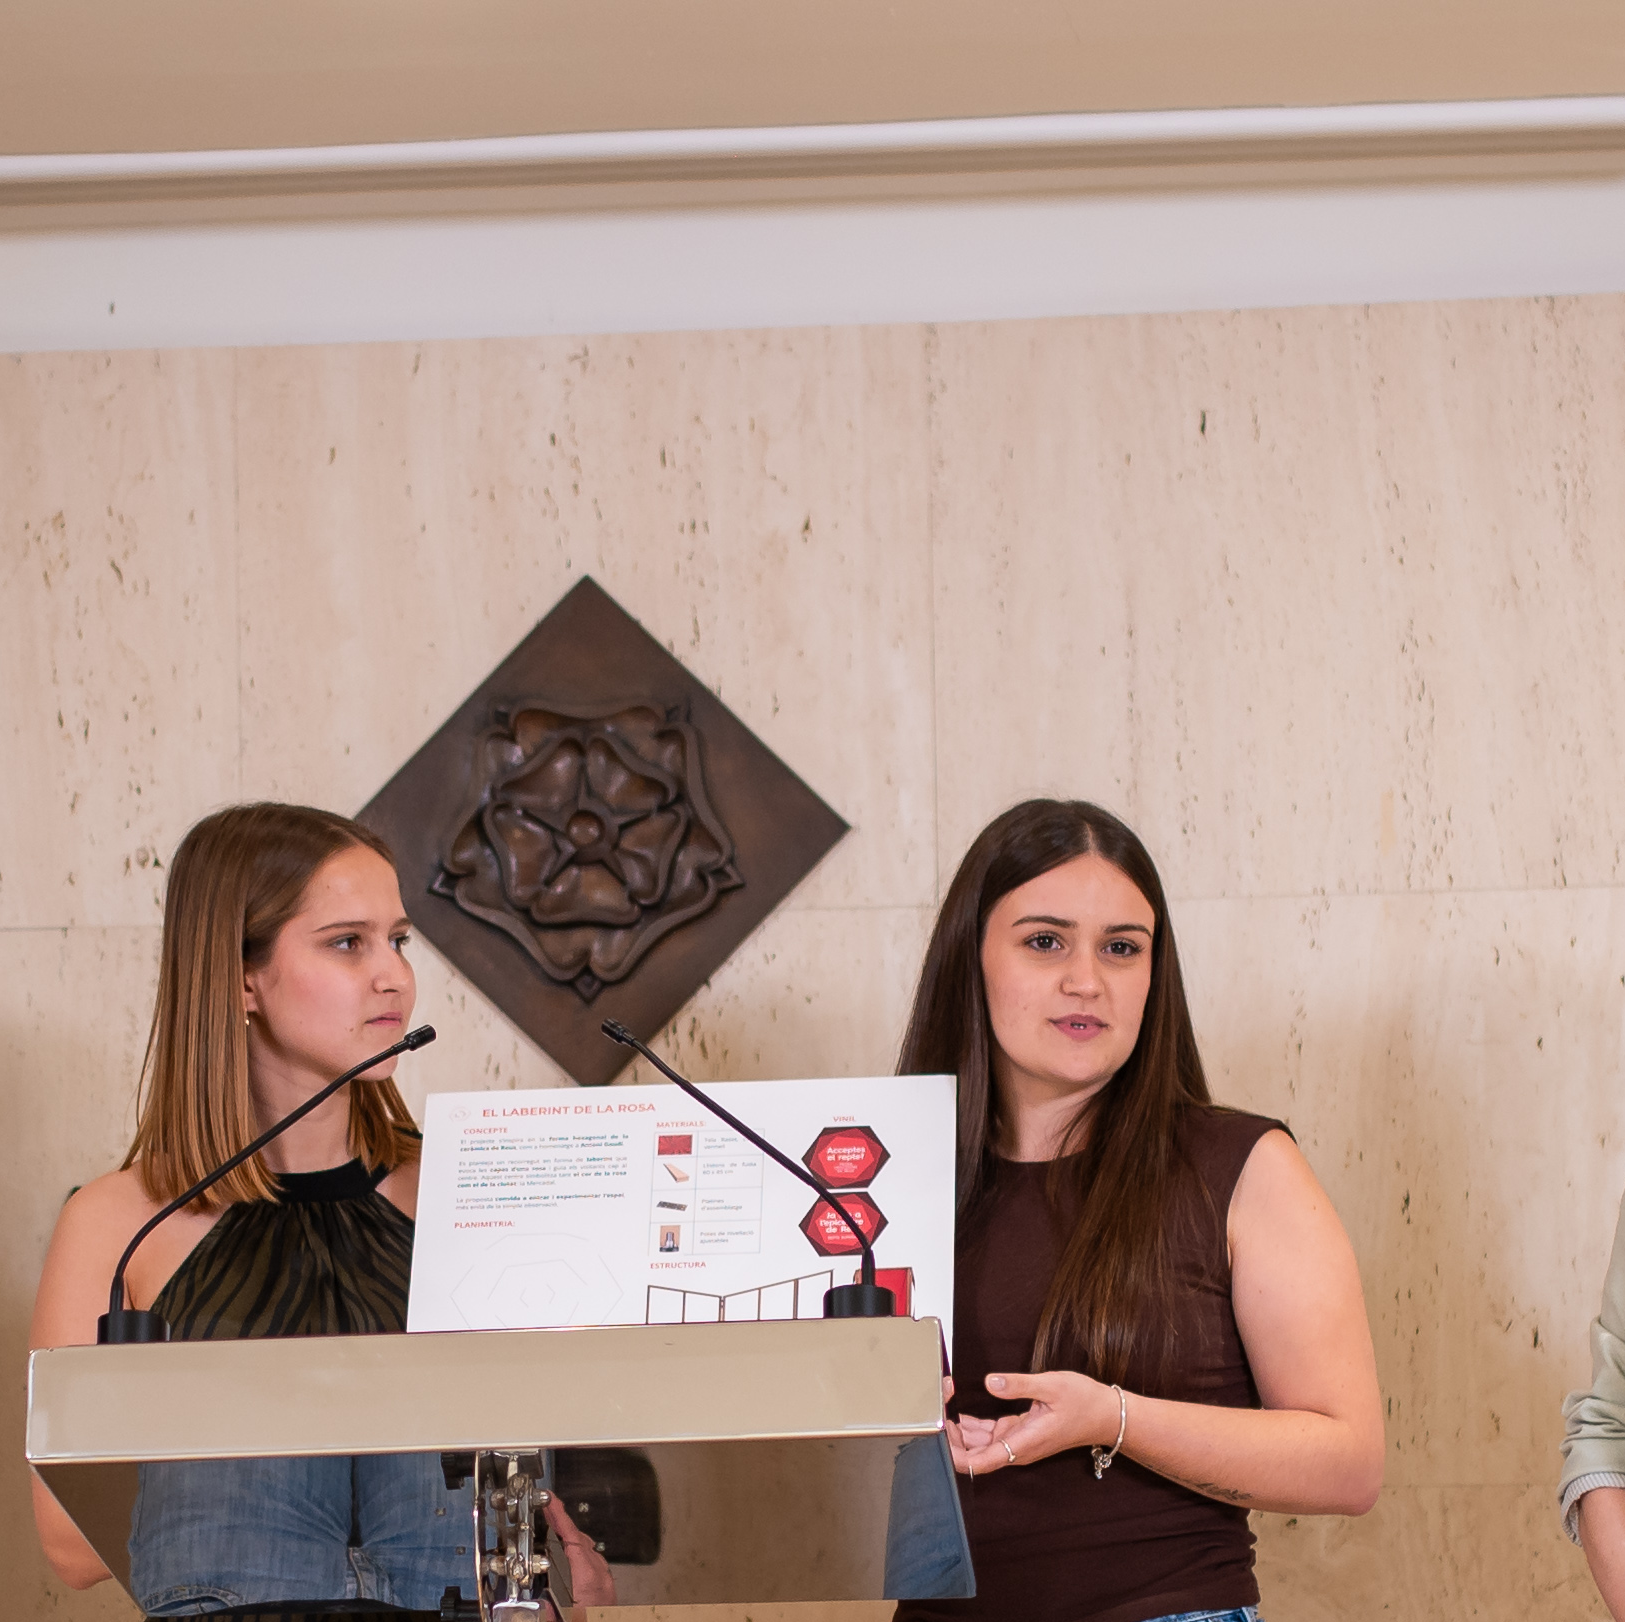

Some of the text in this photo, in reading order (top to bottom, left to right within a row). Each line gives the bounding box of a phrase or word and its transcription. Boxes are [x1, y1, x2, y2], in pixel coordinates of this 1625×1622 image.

[482, 1103, 656, 1117] EL LABERINT DE LA ROSA
[463, 1127, 508, 1135] CONCEPTE
[826, 1146, 866, 1154] Acceptes
[650, 1261, 706, 1269] ESTRUCTURA
